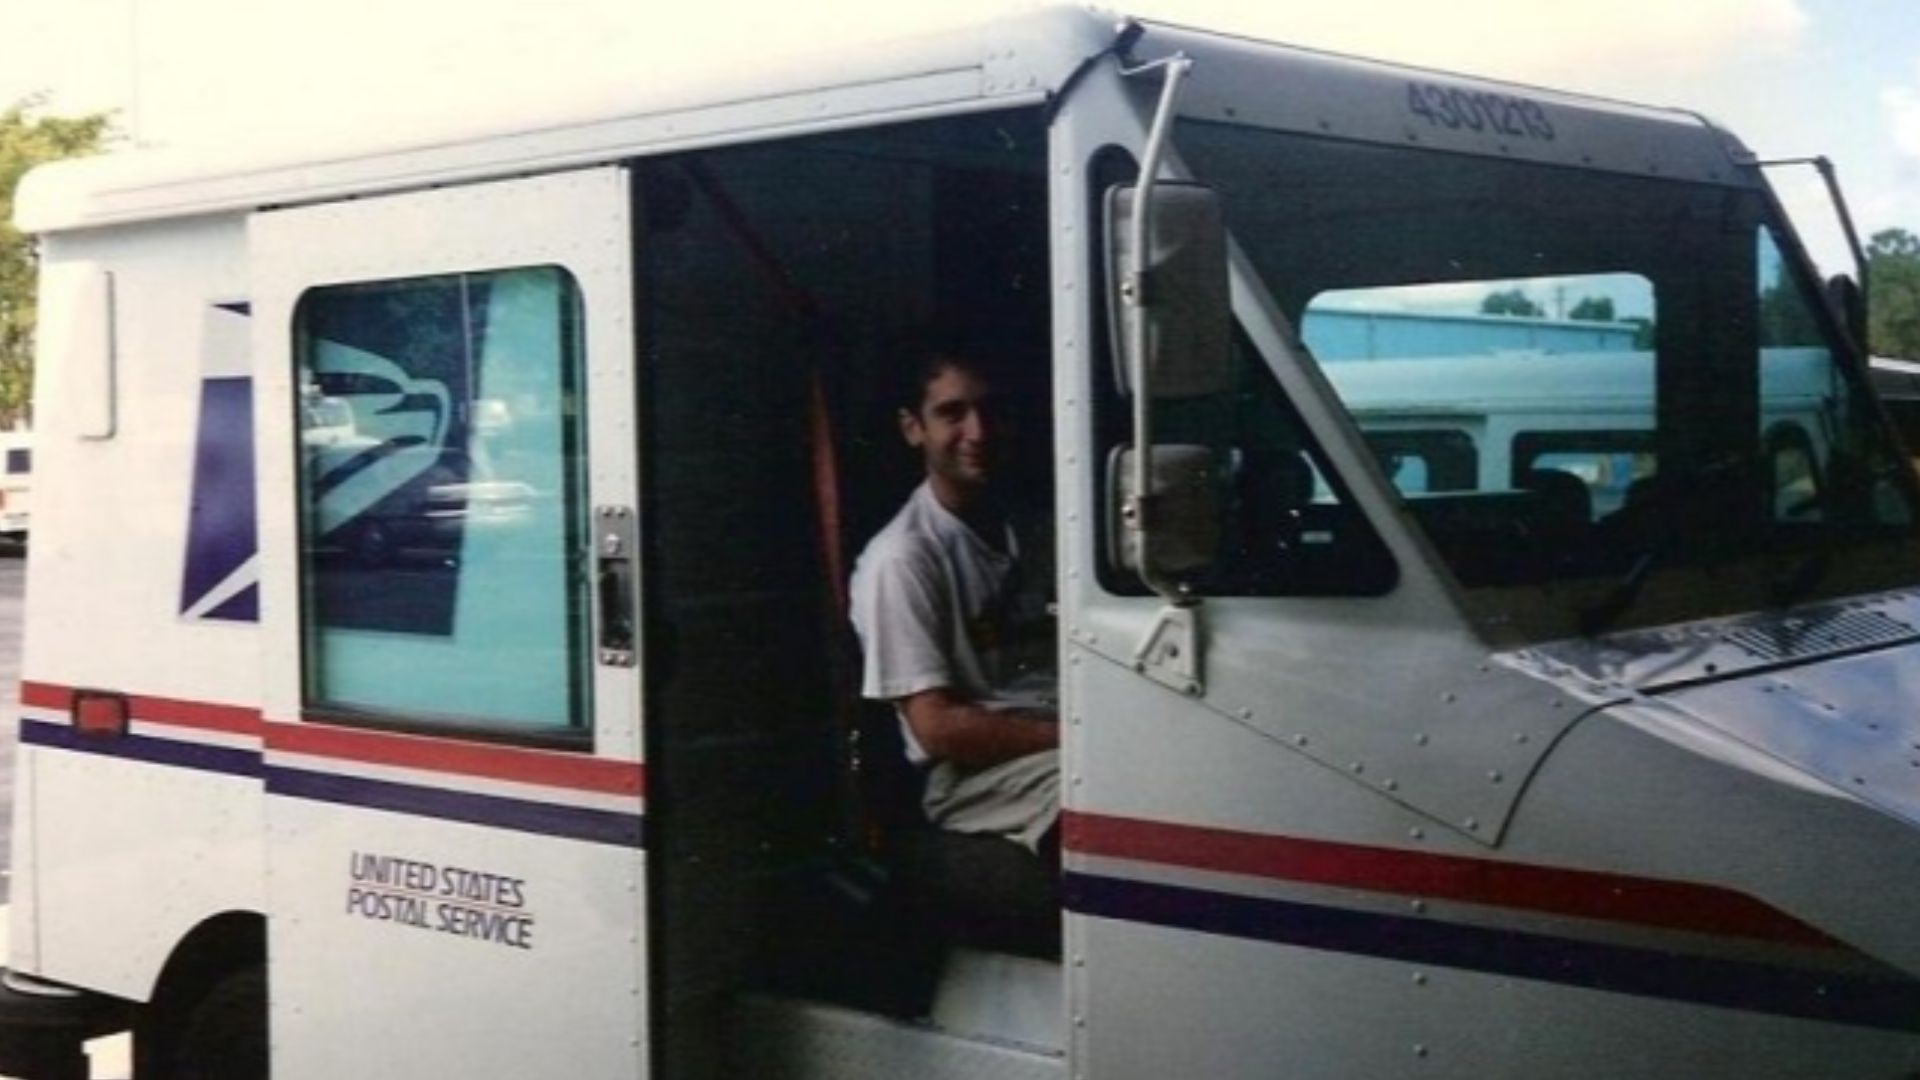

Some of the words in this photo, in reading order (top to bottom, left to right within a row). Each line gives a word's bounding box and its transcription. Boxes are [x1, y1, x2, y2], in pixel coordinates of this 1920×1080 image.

[1407, 81, 1555, 141] 4301213
[351, 852, 437, 891] UNITED
[439, 866, 526, 908] STATES
[346, 888, 431, 929] POSTAL
[436, 903, 535, 950] SERVICE
